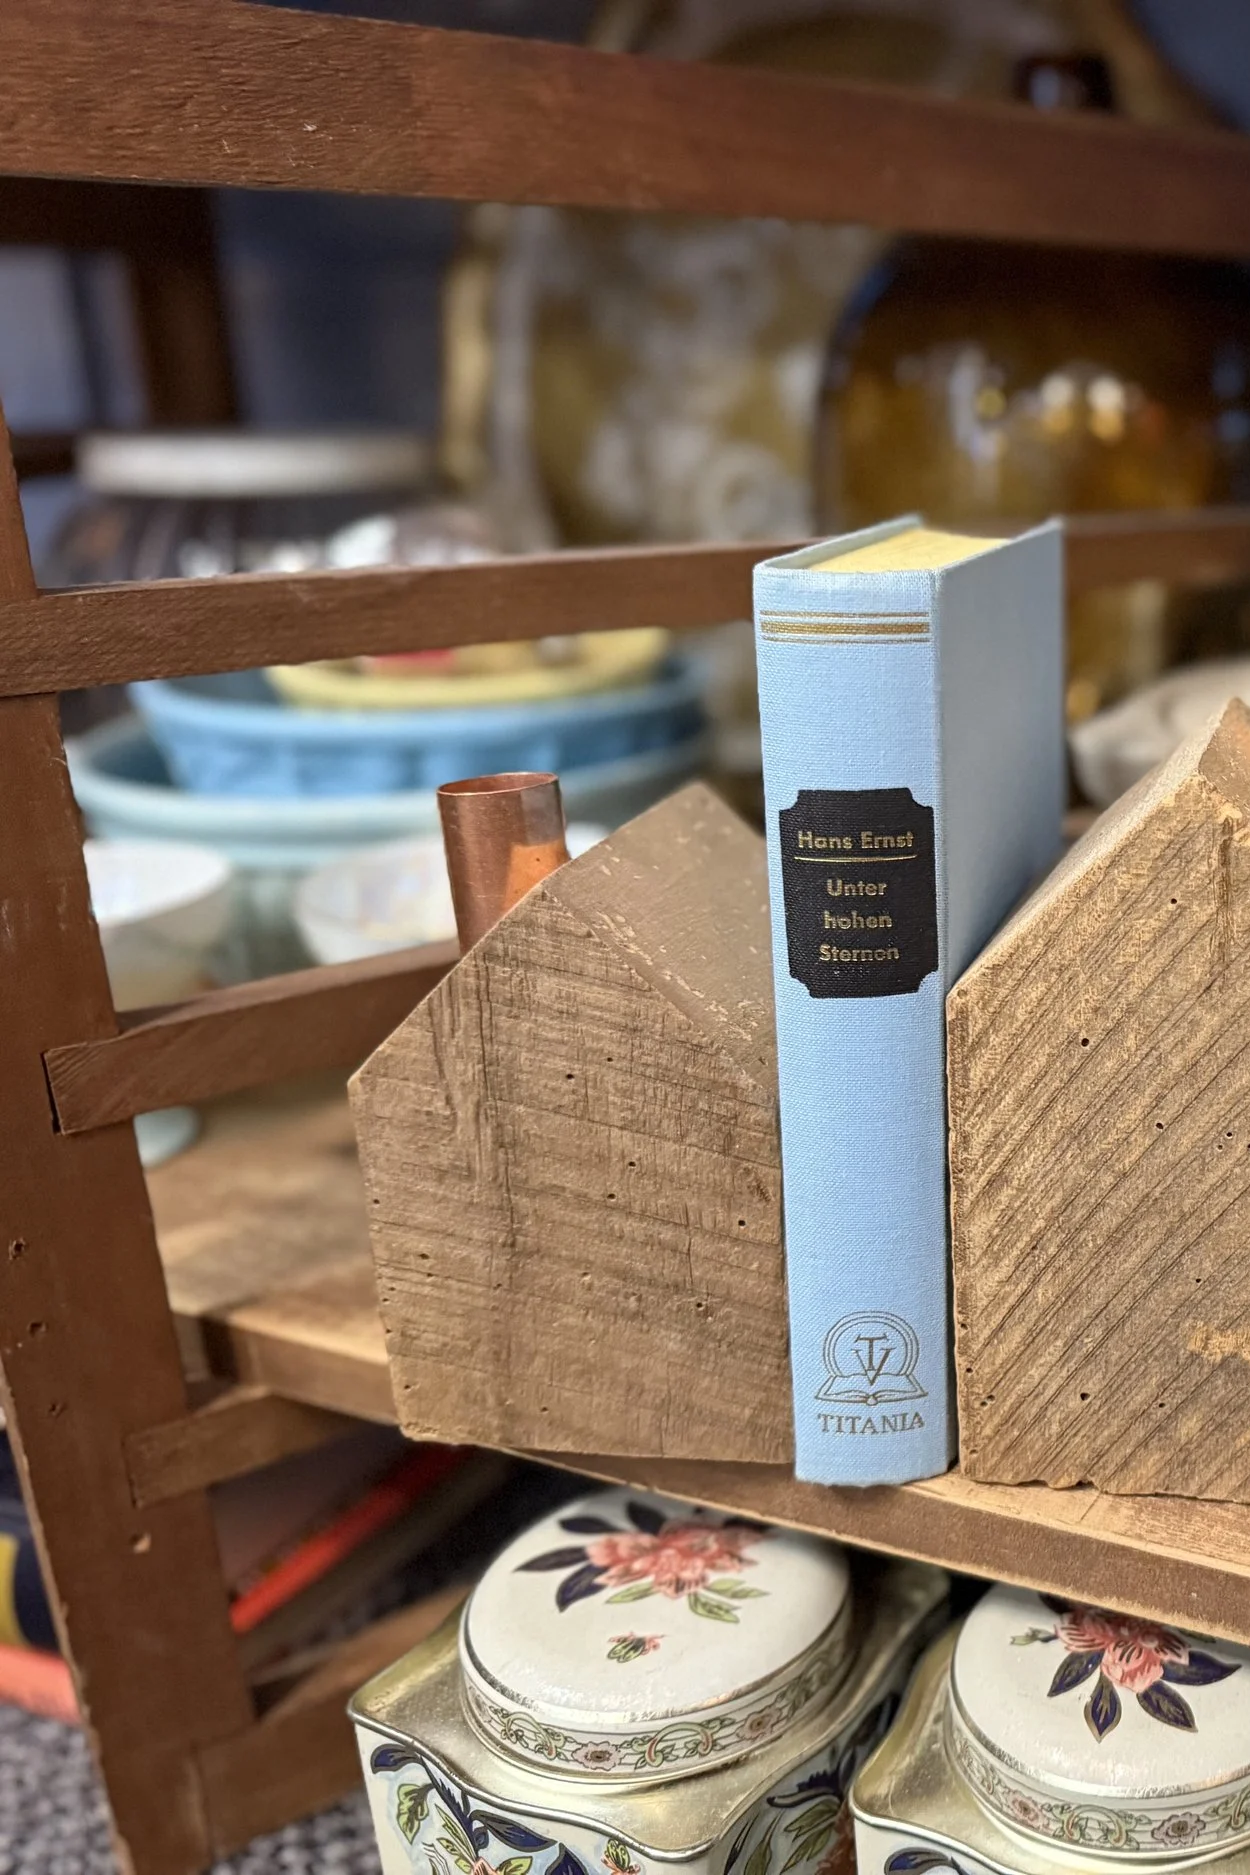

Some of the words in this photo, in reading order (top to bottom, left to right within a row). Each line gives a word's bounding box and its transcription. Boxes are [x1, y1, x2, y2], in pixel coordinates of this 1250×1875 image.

[797, 830, 853, 850] Hans
[860, 830, 915, 849] Ernst
[826, 878, 888, 897] Unter
[823, 910, 893, 929] hohen
[819, 943, 900, 962] Sternen
[817, 1411, 926, 1435] TITANIA
